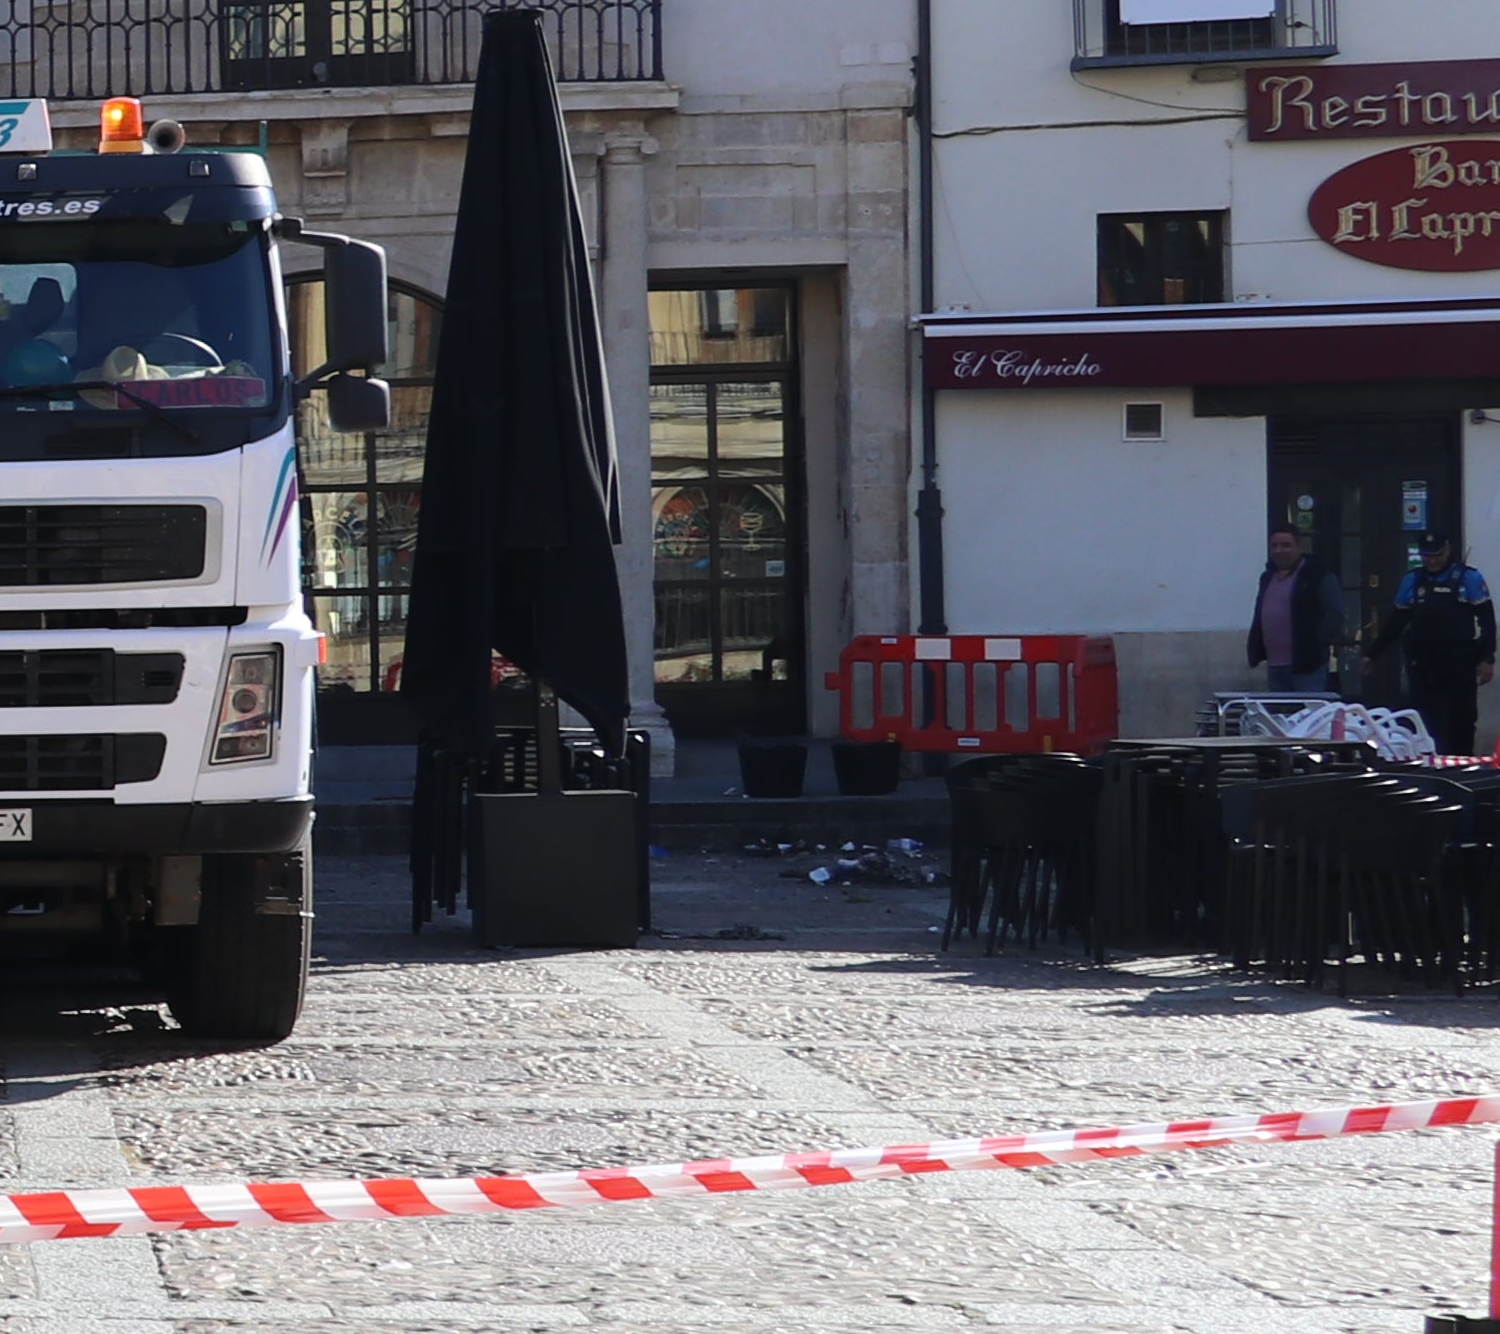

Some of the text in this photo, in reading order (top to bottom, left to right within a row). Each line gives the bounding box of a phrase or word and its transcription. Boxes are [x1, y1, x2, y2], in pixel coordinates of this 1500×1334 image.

[1333, 201, 1380, 244] El
[953, 350, 1102, 385] El Capricho
